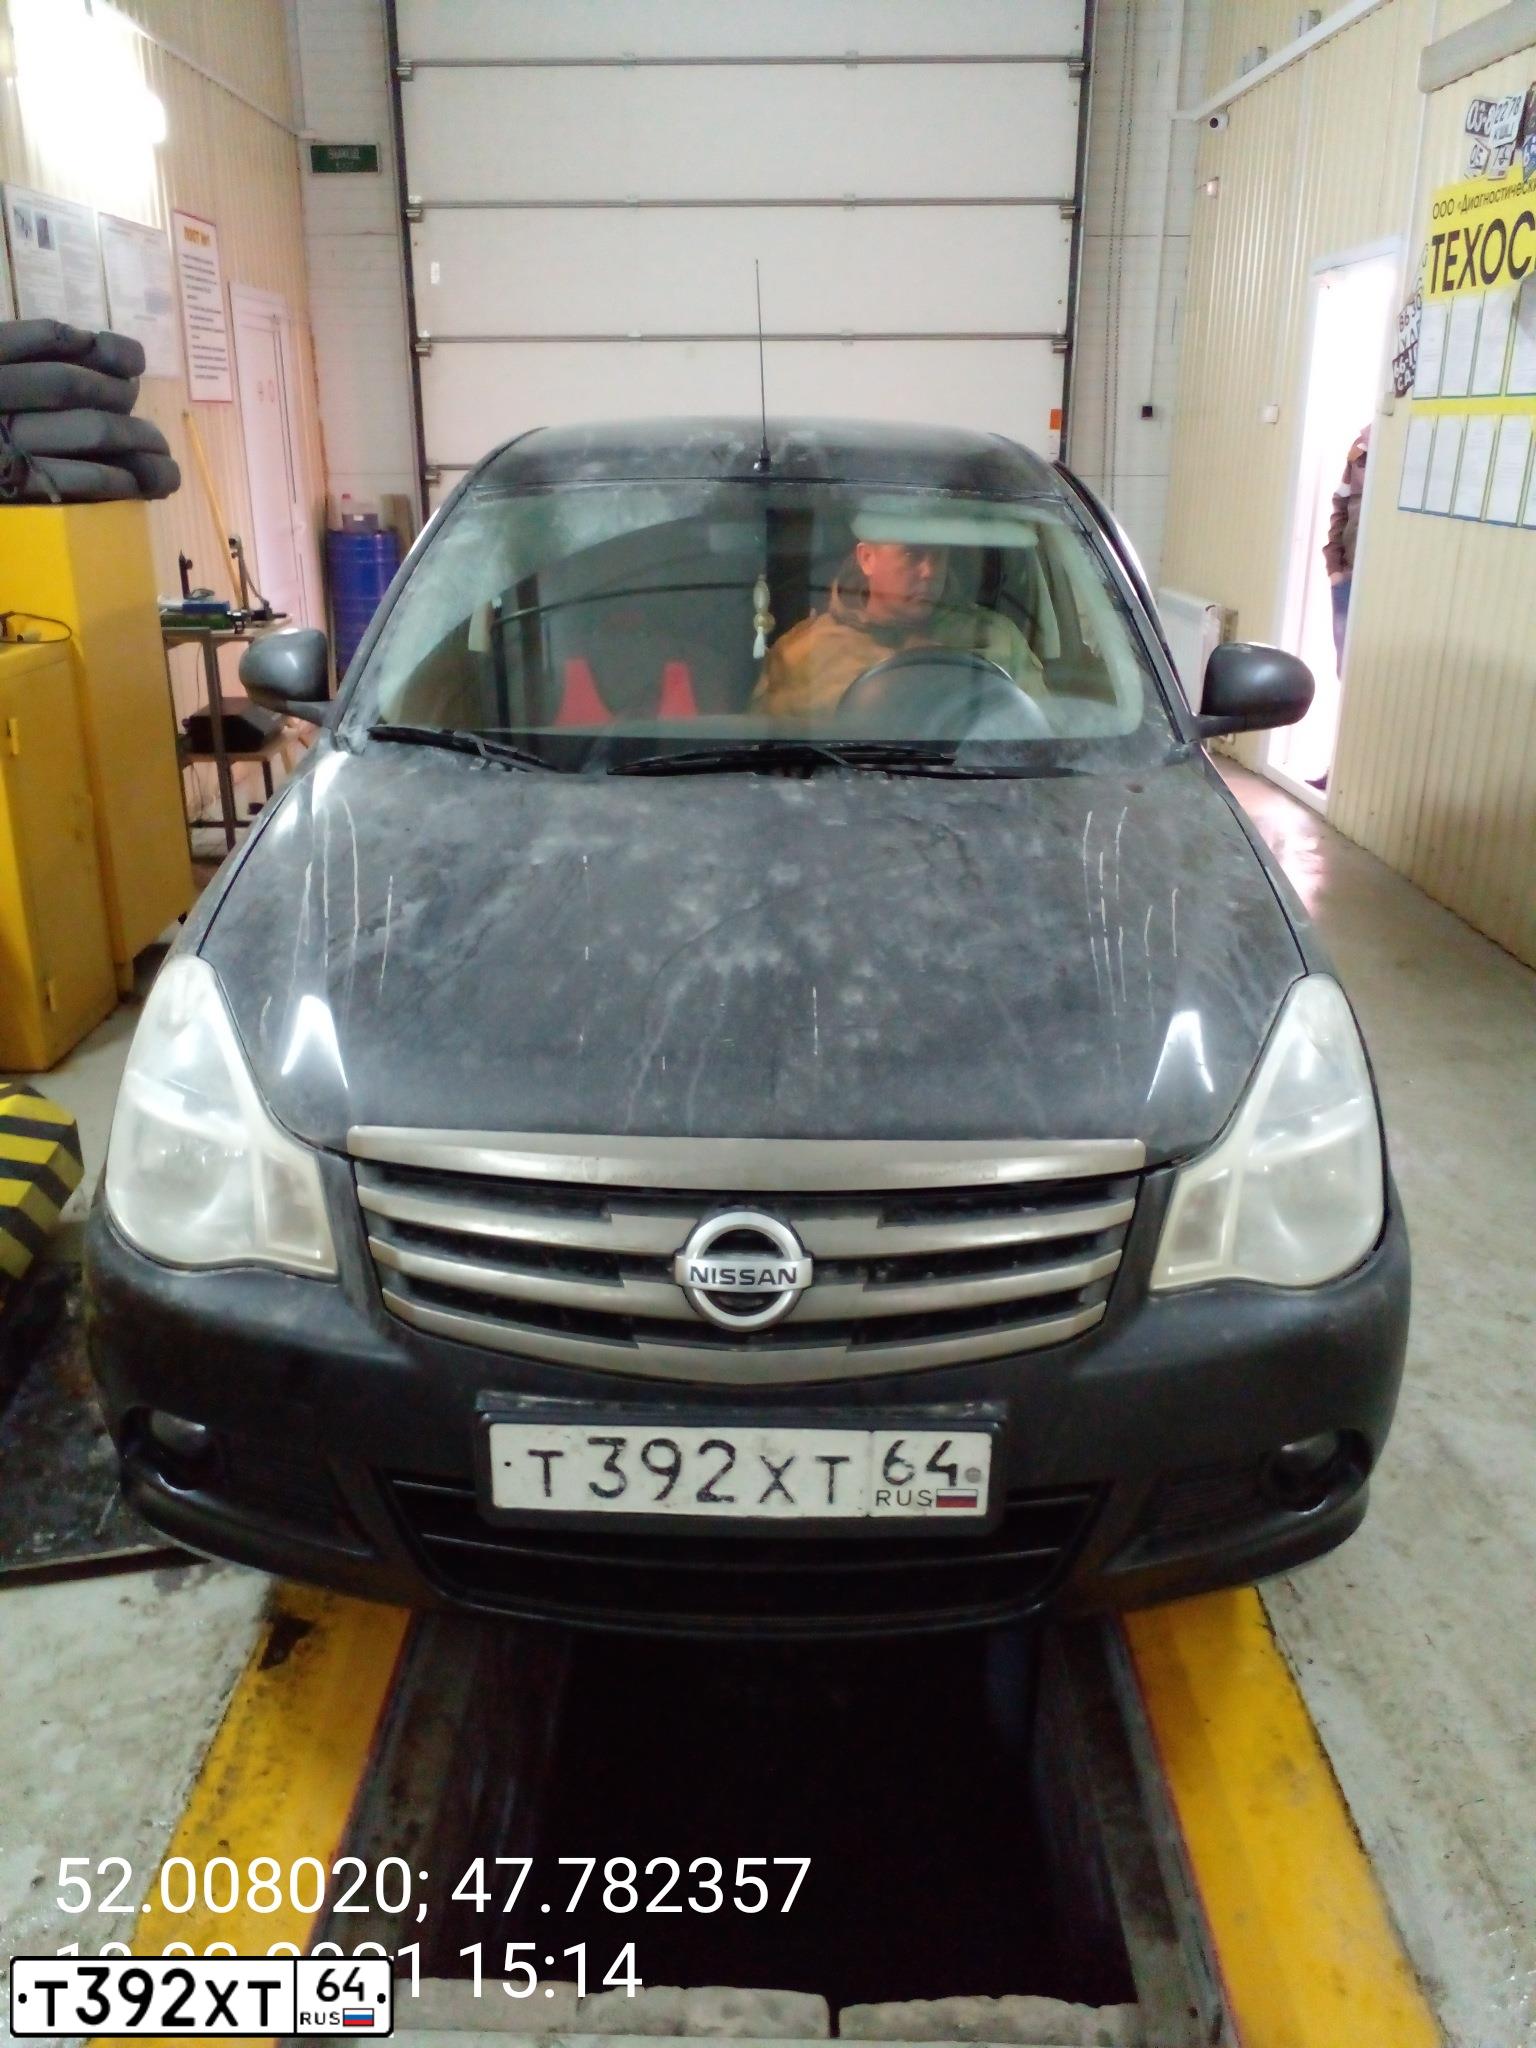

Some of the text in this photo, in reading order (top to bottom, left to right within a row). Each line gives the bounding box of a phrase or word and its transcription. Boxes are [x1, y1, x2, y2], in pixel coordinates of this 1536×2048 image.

[1432, 198, 1455, 220] ООО
[1431, 210, 1536, 294] ТЕХОС
[690, 1266, 797, 1286] NISSAN
[527, 1437, 958, 1505] Т392ХТ 64
[875, 1489, 933, 1507] RUS
